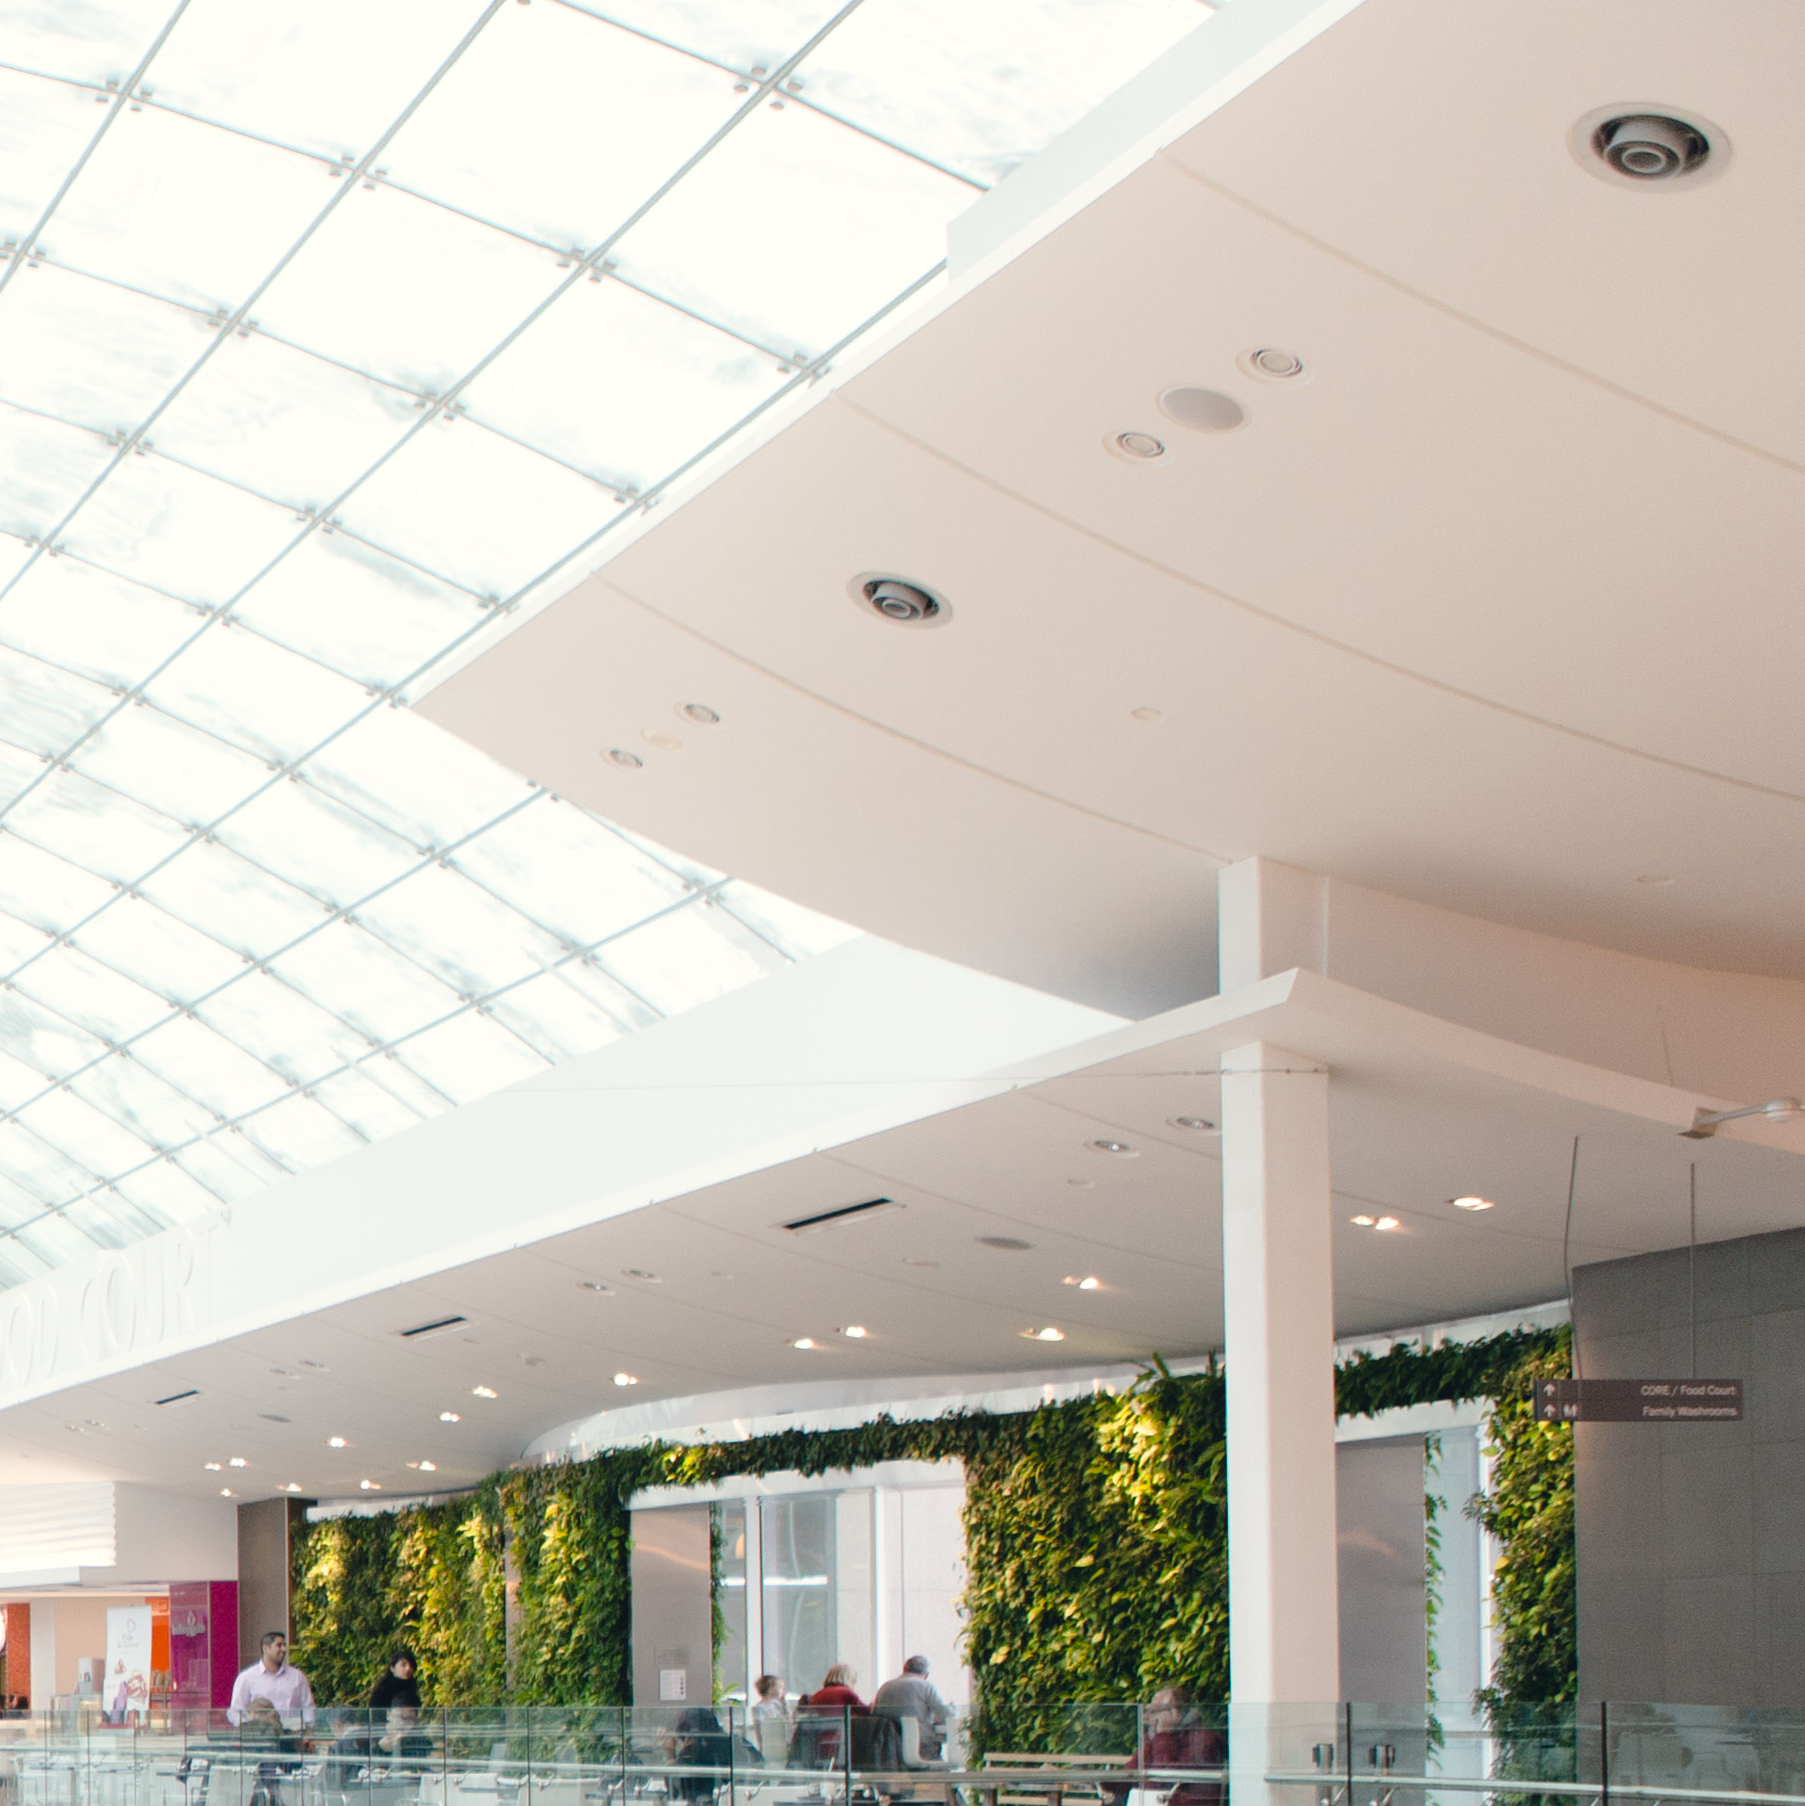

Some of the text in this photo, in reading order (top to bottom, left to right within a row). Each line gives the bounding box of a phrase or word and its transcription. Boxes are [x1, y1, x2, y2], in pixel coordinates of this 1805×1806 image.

[79, 1225, 223, 1361] COURT
[1641, 1384, 1671, 1397] CORE
[1680, 1384, 1705, 1396] Food
[1707, 1384, 1737, 1396] Court
[1642, 1405, 1739, 1418] Family Washrooms
